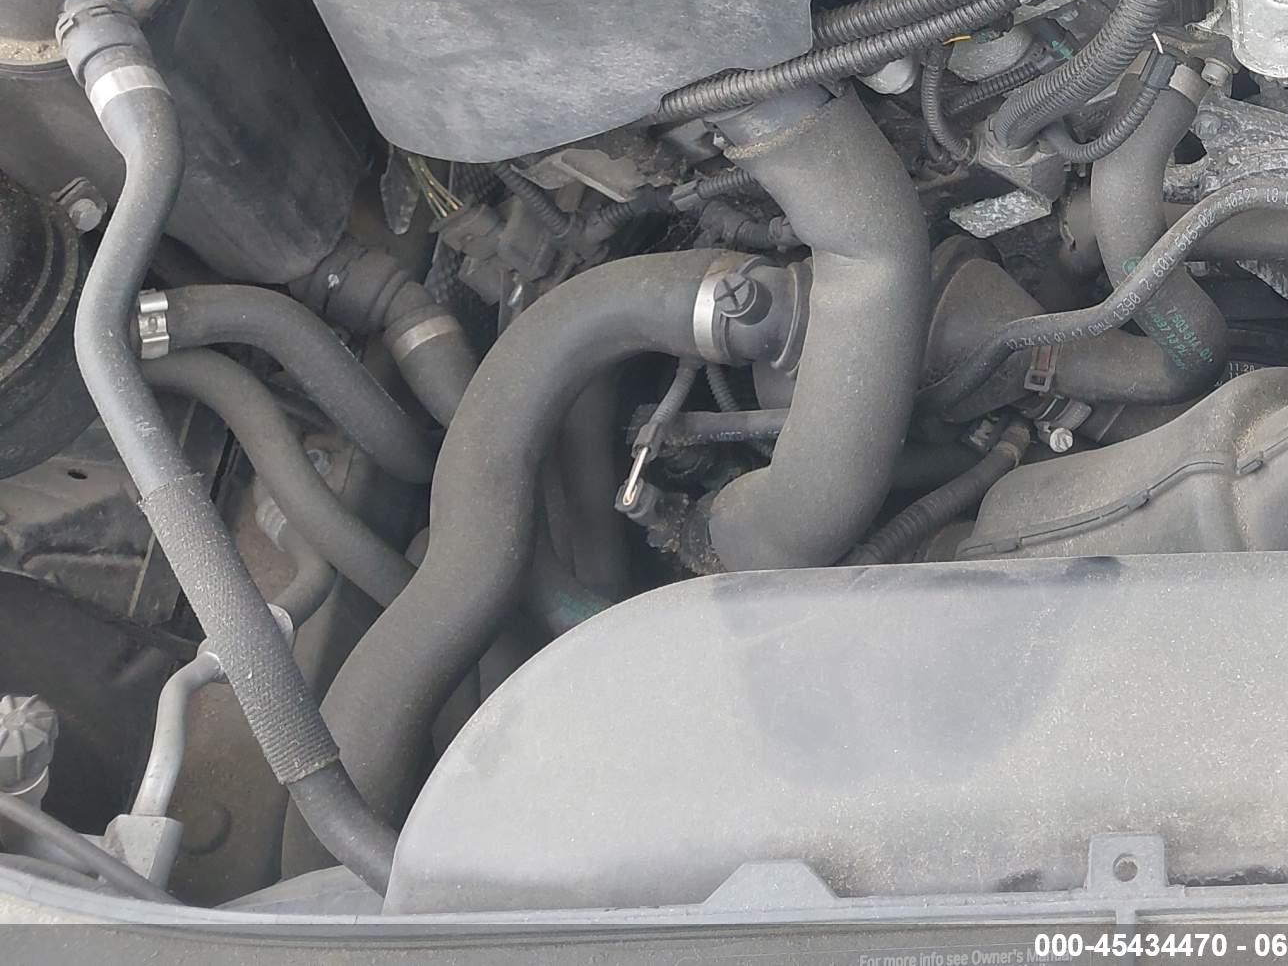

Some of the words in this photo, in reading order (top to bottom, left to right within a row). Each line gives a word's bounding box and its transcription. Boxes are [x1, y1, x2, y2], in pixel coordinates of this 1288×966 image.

[859, 954, 881, 966] For
[883, 955, 917, 966] more
[919, 952, 944, 965] info
[946, 953, 969, 965] see
[971, 949, 1024, 965] Owner's
